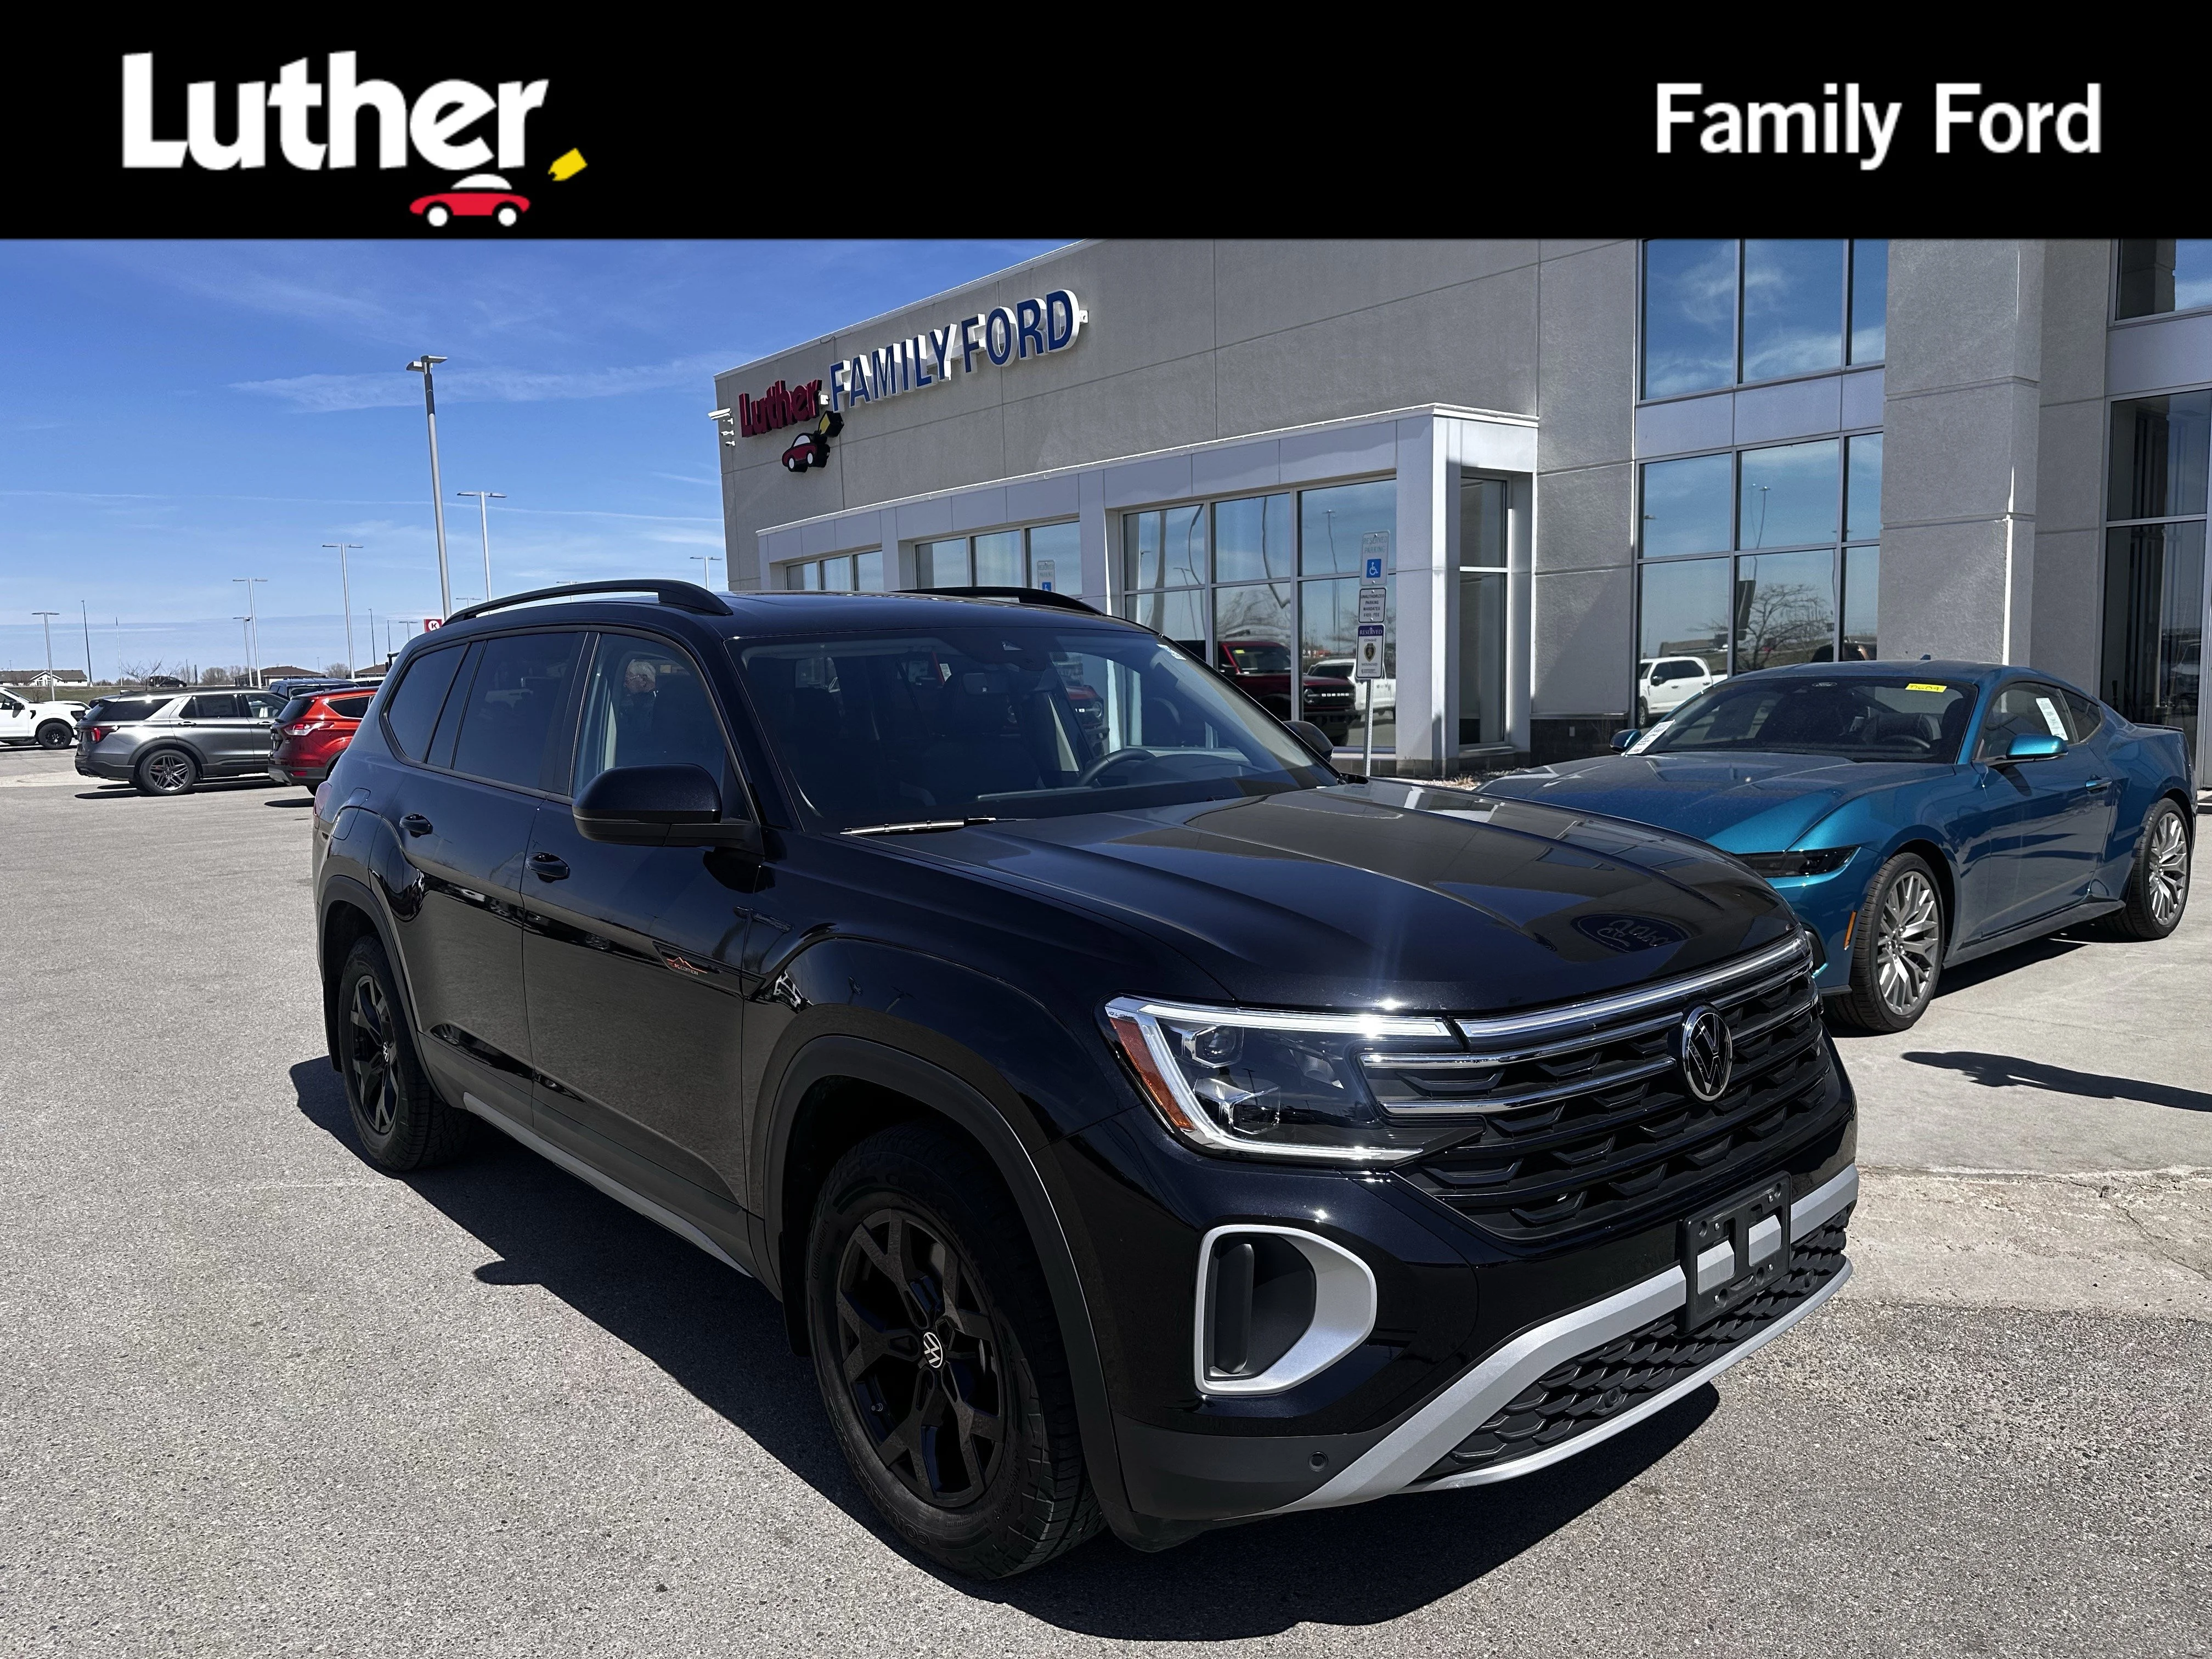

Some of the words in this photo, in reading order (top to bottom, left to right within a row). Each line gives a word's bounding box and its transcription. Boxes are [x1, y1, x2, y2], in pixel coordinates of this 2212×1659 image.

[830, 324, 957, 412] FAMILY
[961, 289, 1079, 374] FORD
[738, 379, 822, 437] Luther
[1363, 536, 1387, 545] RESERVED
[1364, 545, 1386, 554] PARKING
[680, 966, 698, 975] EDITION
